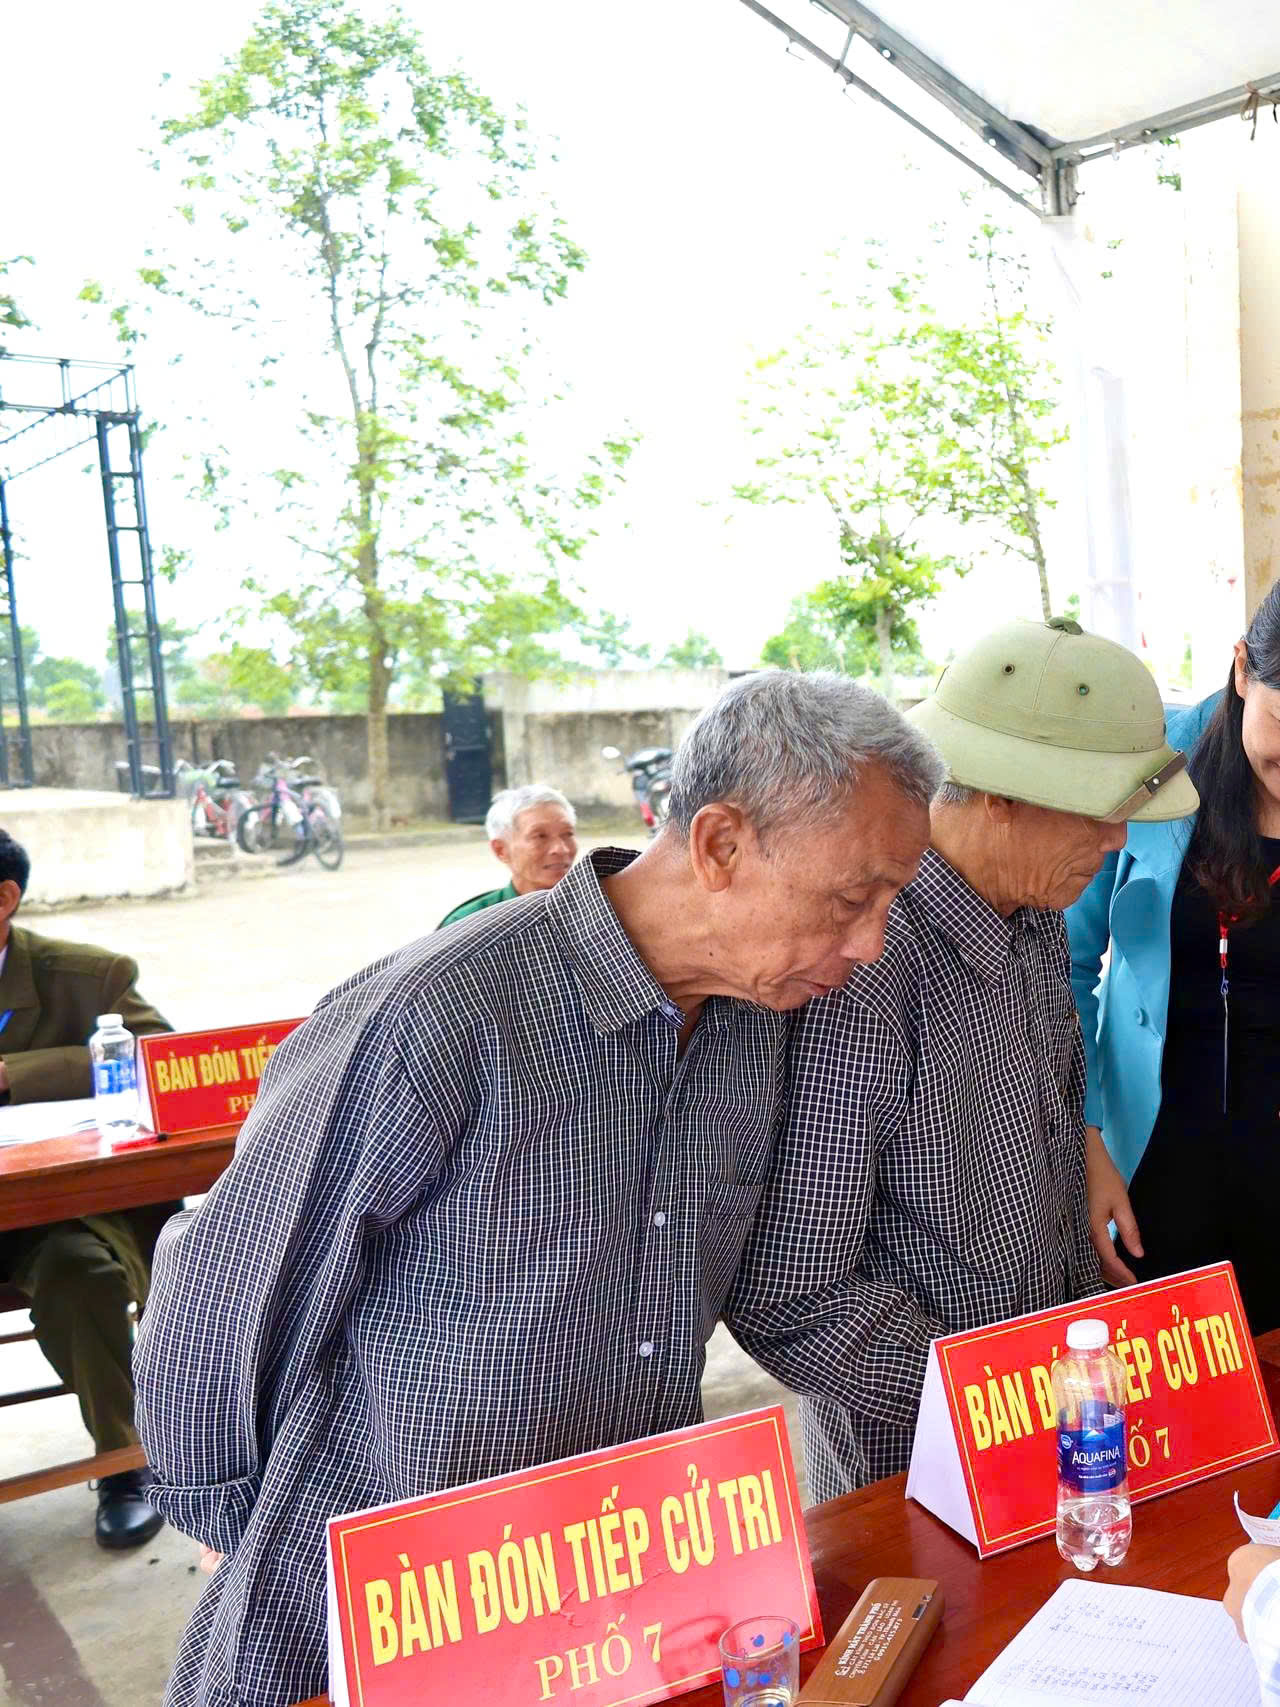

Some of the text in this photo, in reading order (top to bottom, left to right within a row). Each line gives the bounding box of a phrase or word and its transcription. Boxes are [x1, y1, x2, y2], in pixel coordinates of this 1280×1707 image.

[155, 1051, 198, 1093] BÀN
[199, 1045, 240, 1086] ĐÓN
[963, 1365, 1035, 1451] BÀN
[1156, 1304, 1199, 1391] CỬ
[1196, 1311, 1244, 1378] TRI
[1072, 1445, 1121, 1466] AQUAFINA
[1155, 1427, 1171, 1459] 7
[364, 1463, 783, 1667] BÀN ĐÓN TIẾP CỬ TRI
[535, 1612, 664, 1701] PHỐ 7
